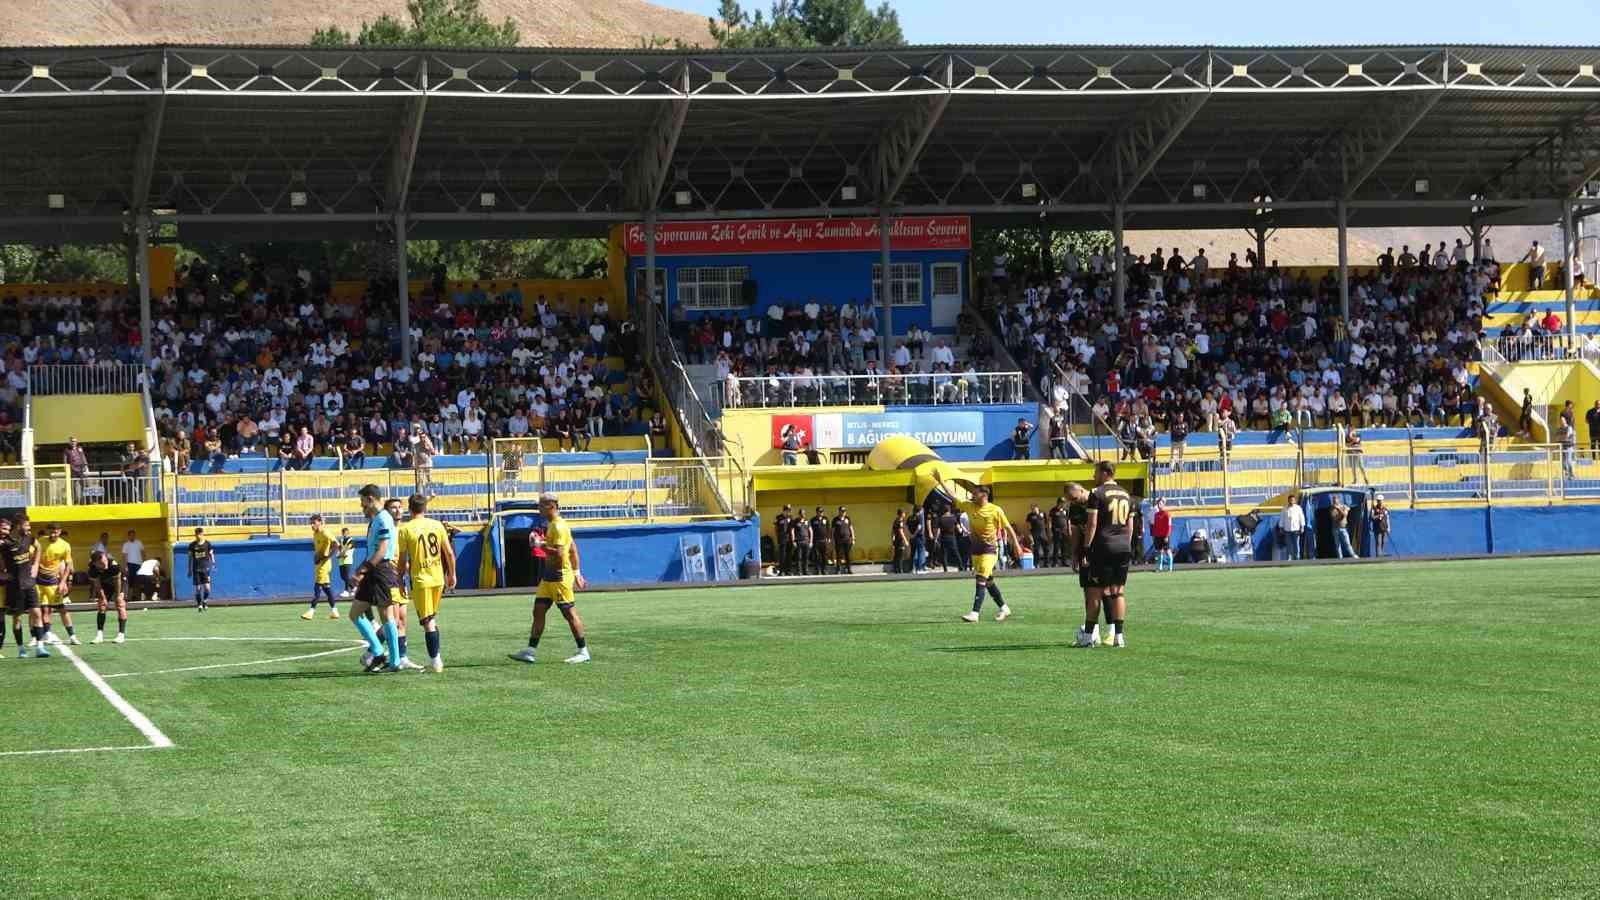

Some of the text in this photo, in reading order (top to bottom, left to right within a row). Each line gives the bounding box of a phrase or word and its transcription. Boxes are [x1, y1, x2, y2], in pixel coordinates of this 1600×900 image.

[629, 226, 648, 243] Be
[711, 223, 735, 244] Zeki
[737, 223, 767, 244] Çevik
[769, 230, 781, 241] ve
[815, 221, 863, 240] Zamanda
[927, 219, 968, 236] Severim
[914, 431, 976, 445] STADYUMU
[1108, 498, 1130, 526] 10
[418, 532, 439, 558] 18
